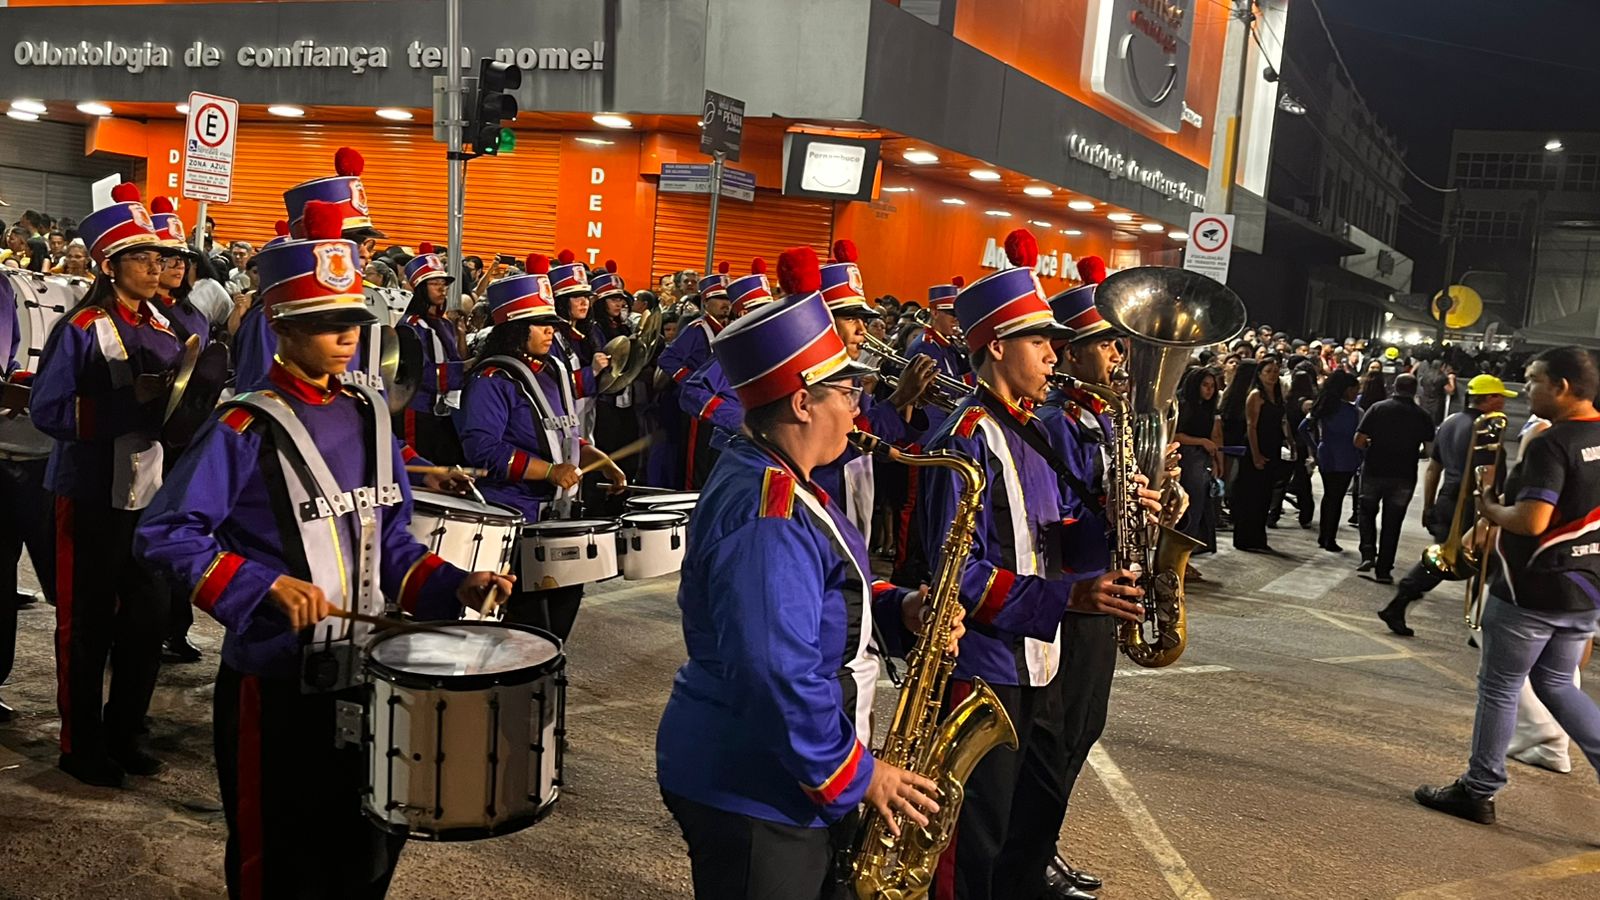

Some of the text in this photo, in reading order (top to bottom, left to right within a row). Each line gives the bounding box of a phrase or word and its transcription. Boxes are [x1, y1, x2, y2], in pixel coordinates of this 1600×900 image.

[14, 41, 169, 74] Odontologia
[184, 42, 221, 67] de
[236, 40, 388, 74] confiança
[495, 41, 605, 71] nome!
[206, 113, 218, 137] E
[189, 159, 206, 168] ZONA
[210, 162, 228, 171] AZUL
